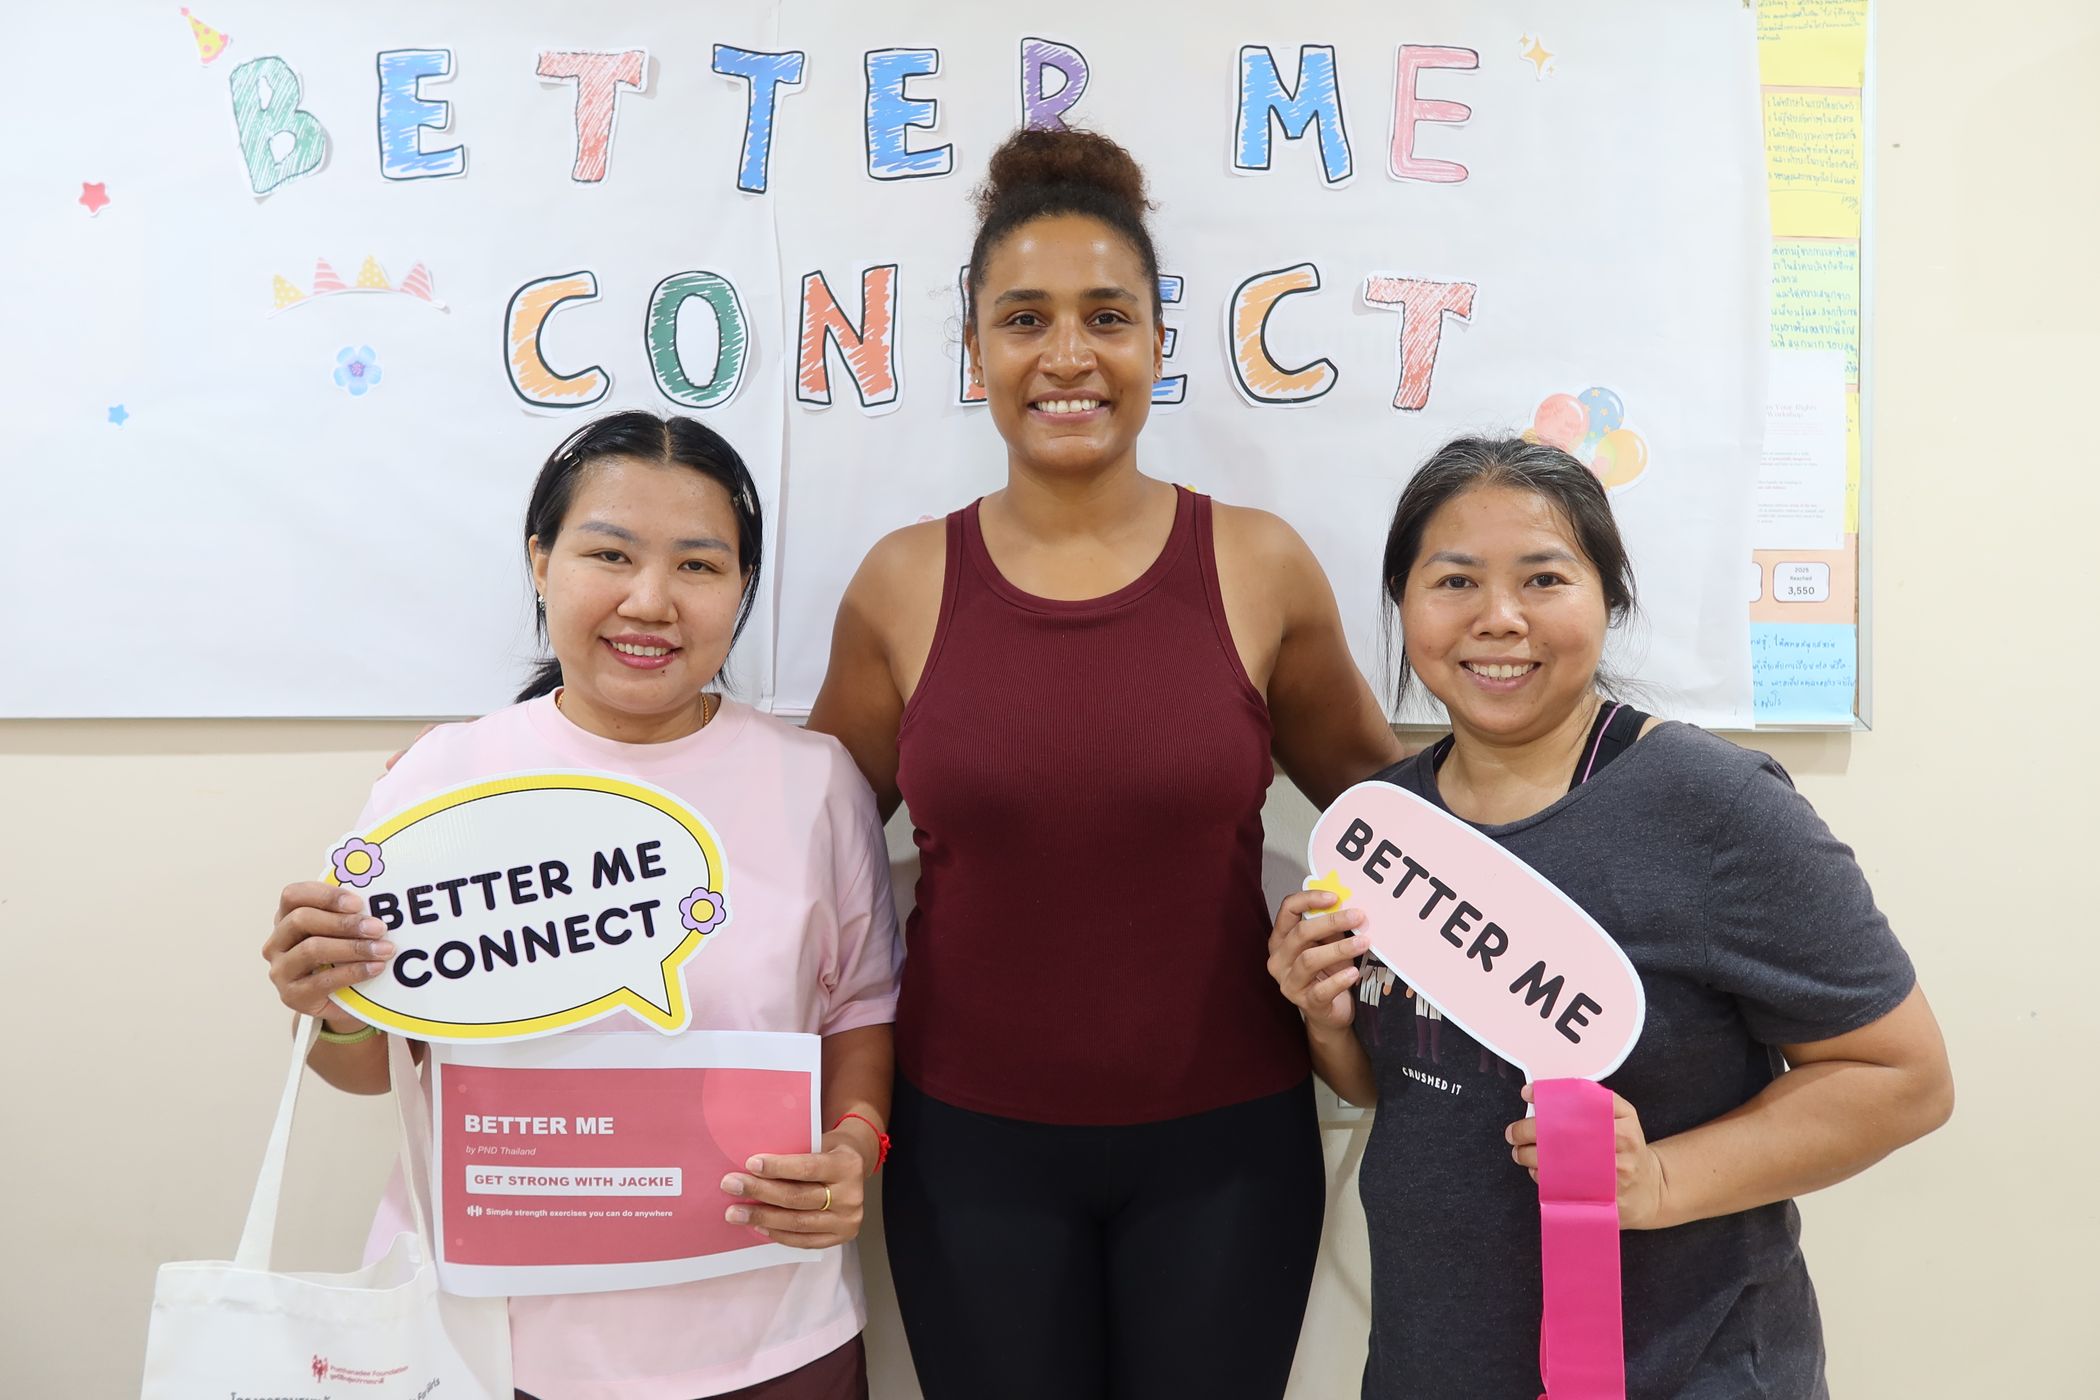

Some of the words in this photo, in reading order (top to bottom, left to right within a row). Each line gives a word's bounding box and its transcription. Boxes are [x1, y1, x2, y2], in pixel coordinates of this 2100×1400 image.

[229, 37, 1089, 194] BETTER
[1234, 44, 1480, 184] ME
[503, 262, 1478, 409] CONCT
[1787, 586, 1815, 596] 3,550
[368, 859, 573, 932] BETTER
[591, 839, 667, 890] ME
[392, 899, 661, 988] CONNECT
[1335, 817, 1509, 972] BETTER
[1508, 960, 1603, 1045] ME
[1402, 1066, 1449, 1091] CRUSHED
[1450, 1083, 1463, 1096] IT
[464, 1114, 568, 1135] BETTER
[575, 1116, 615, 1135] ME
[465, 1145, 476, 1154] by
[477, 1145, 498, 1155] PND
[500, 1147, 537, 1156] Thailand
[474, 1174, 503, 1185] GET
[508, 1175, 570, 1187] STRONG
[575, 1176, 614, 1187] WITH
[618, 1176, 674, 1187] JACKIE
[485, 1208, 513, 1218] Simple
[514, 1208, 548, 1219] strength
[549, 1209, 588, 1218] exercises
[588, 1210, 605, 1220] you
[605, 1210, 621, 1218] can
[622, 1208, 633, 1218] do
[634, 1208, 673, 1219] anywhere
